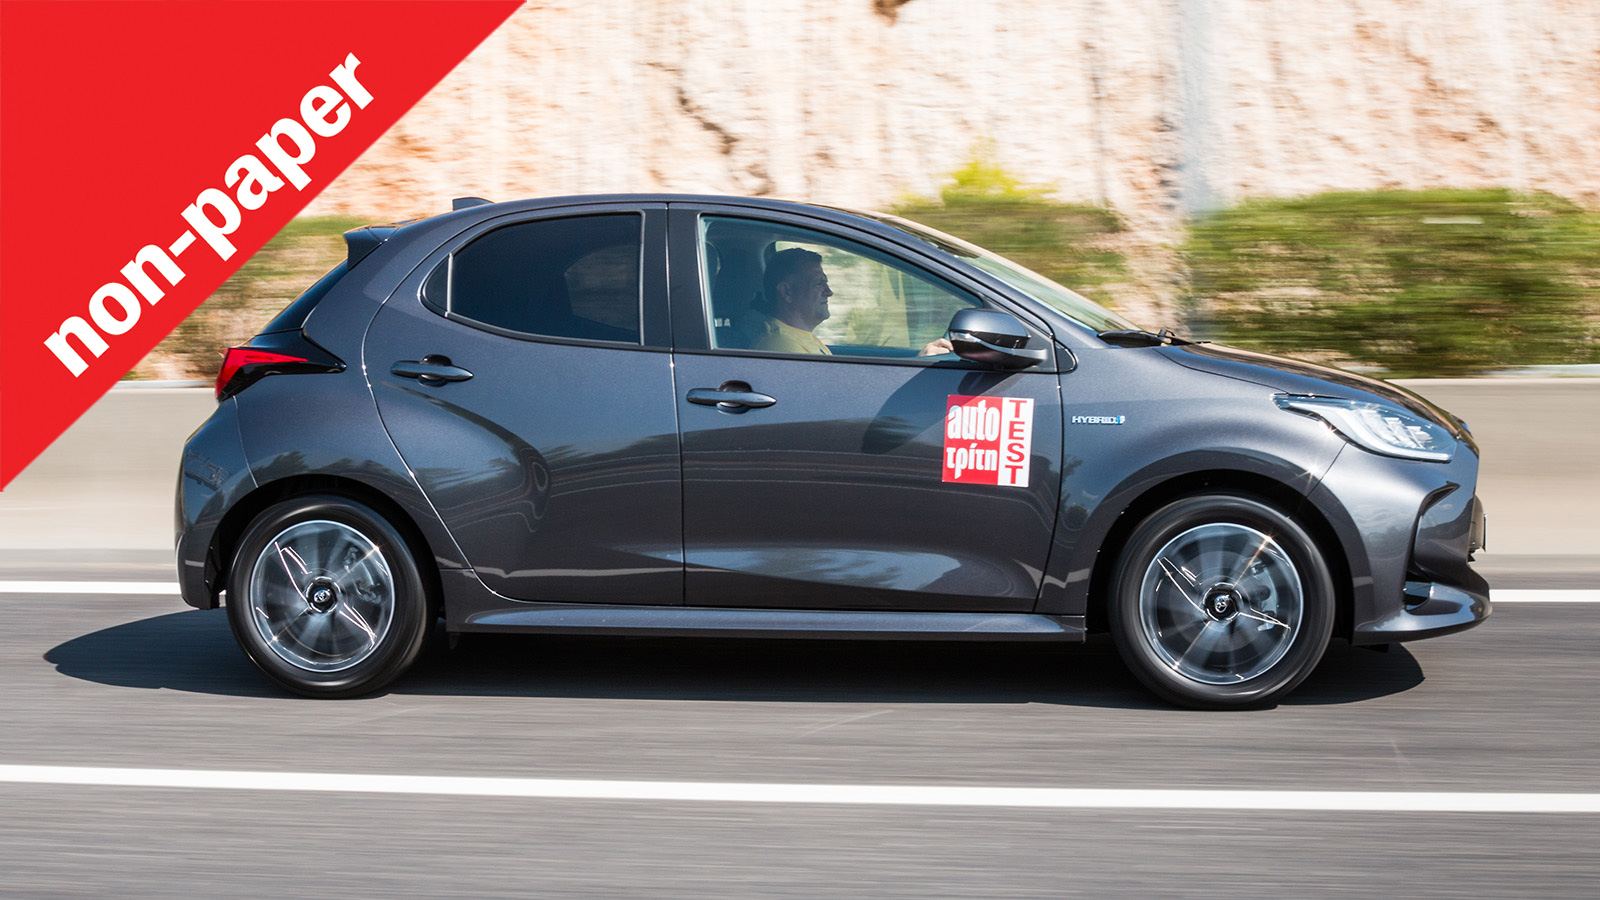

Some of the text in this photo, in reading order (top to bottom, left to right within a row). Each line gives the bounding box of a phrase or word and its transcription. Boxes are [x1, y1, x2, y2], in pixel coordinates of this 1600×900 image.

[947, 400, 1000, 442] auto
[1072, 415, 1117, 425] HYBRID
[946, 443, 998, 479] τρίτη
[1004, 400, 1027, 484] TEST
